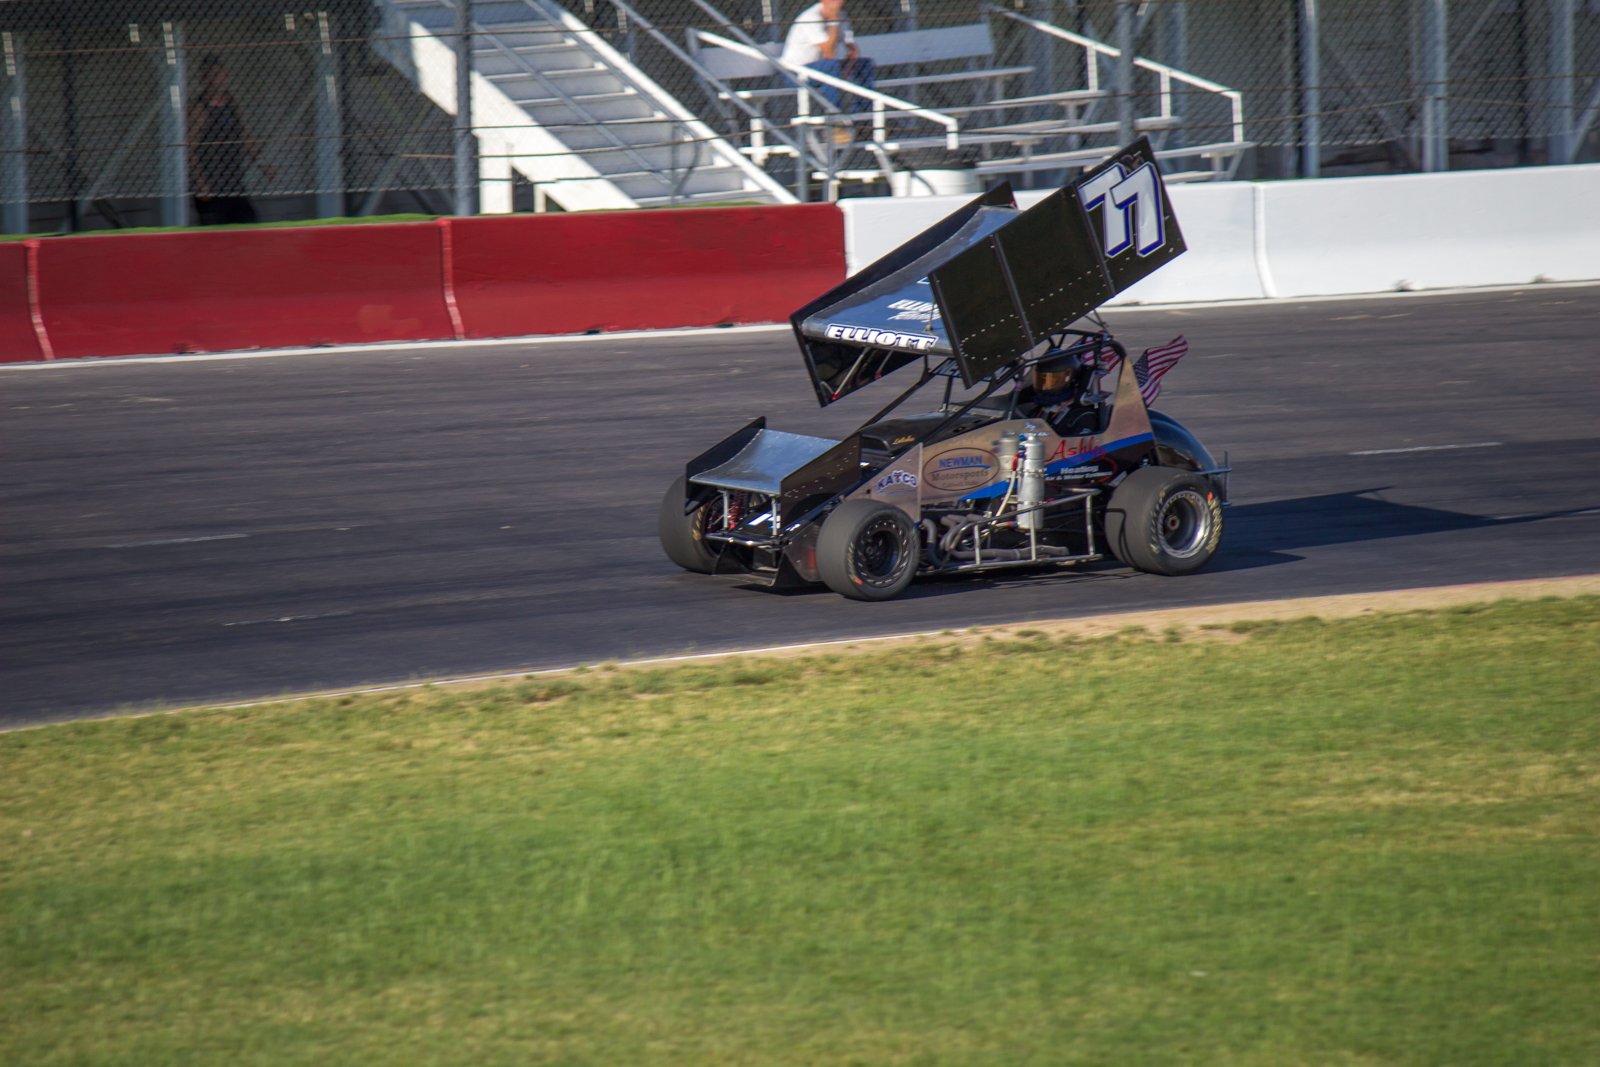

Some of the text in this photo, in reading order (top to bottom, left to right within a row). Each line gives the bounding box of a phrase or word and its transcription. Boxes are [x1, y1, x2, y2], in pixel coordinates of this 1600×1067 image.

[1078, 161, 1167, 259] 77
[825, 323, 939, 351] ELLIOTT
[1045, 436, 1107, 462] Ashley
[939, 455, 983, 469] NEWMAN
[1060, 465, 1099, 475] Heating
[876, 469, 919, 492] KATCO
[931, 469, 990, 482] Motorsports
